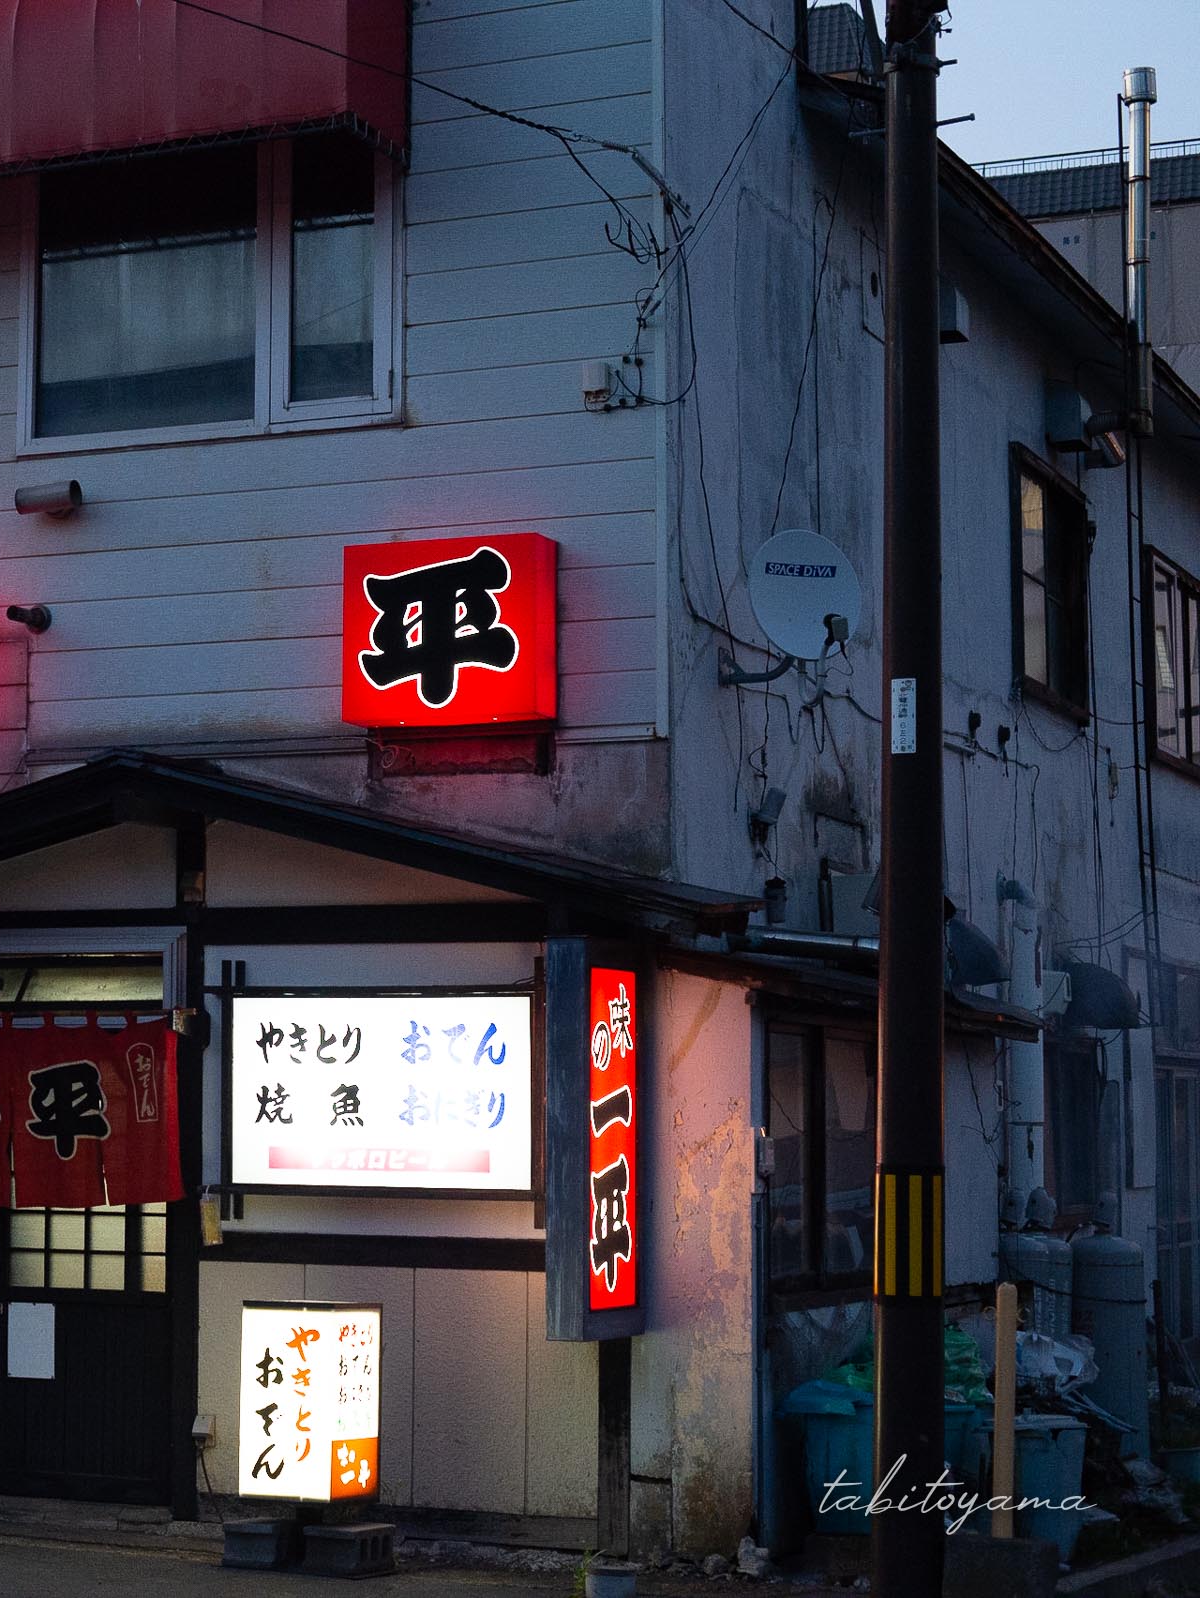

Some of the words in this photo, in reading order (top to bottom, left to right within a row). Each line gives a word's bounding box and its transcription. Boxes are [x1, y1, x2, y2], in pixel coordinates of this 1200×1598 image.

[767, 563, 800, 576] SPACE
[357, 545, 520, 709] 平
[134, 1053, 155, 1118] おでん
[255, 1021, 362, 1064] やきとり
[400, 1020, 506, 1066] おでん
[251, 1347, 285, 1480] おでん
[286, 1326, 321, 1462] やきとり
